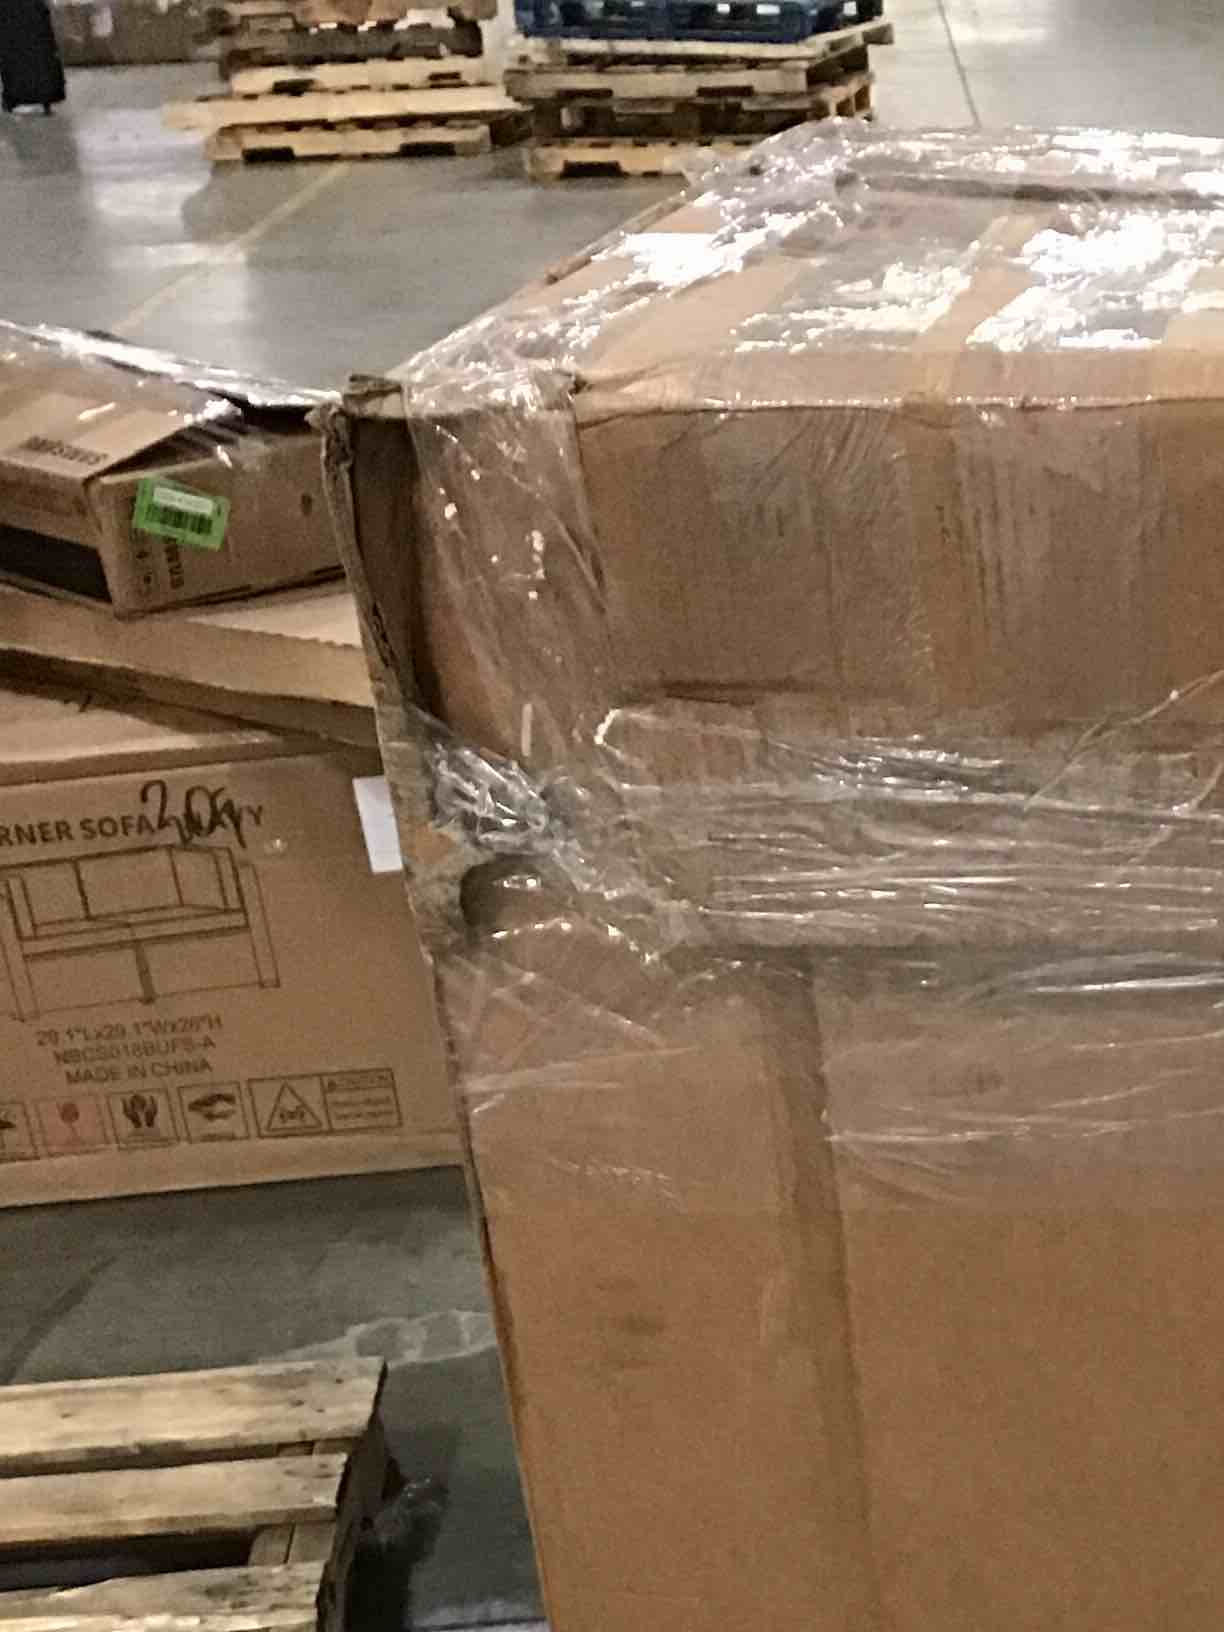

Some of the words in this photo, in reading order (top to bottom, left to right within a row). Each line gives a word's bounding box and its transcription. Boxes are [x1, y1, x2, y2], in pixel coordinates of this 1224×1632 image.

[79, 813, 156, 838] SOFA
[65, 1064, 122, 1085] MADE
[127, 1063, 147, 1080] IN
[151, 1056, 212, 1078] CHINA
